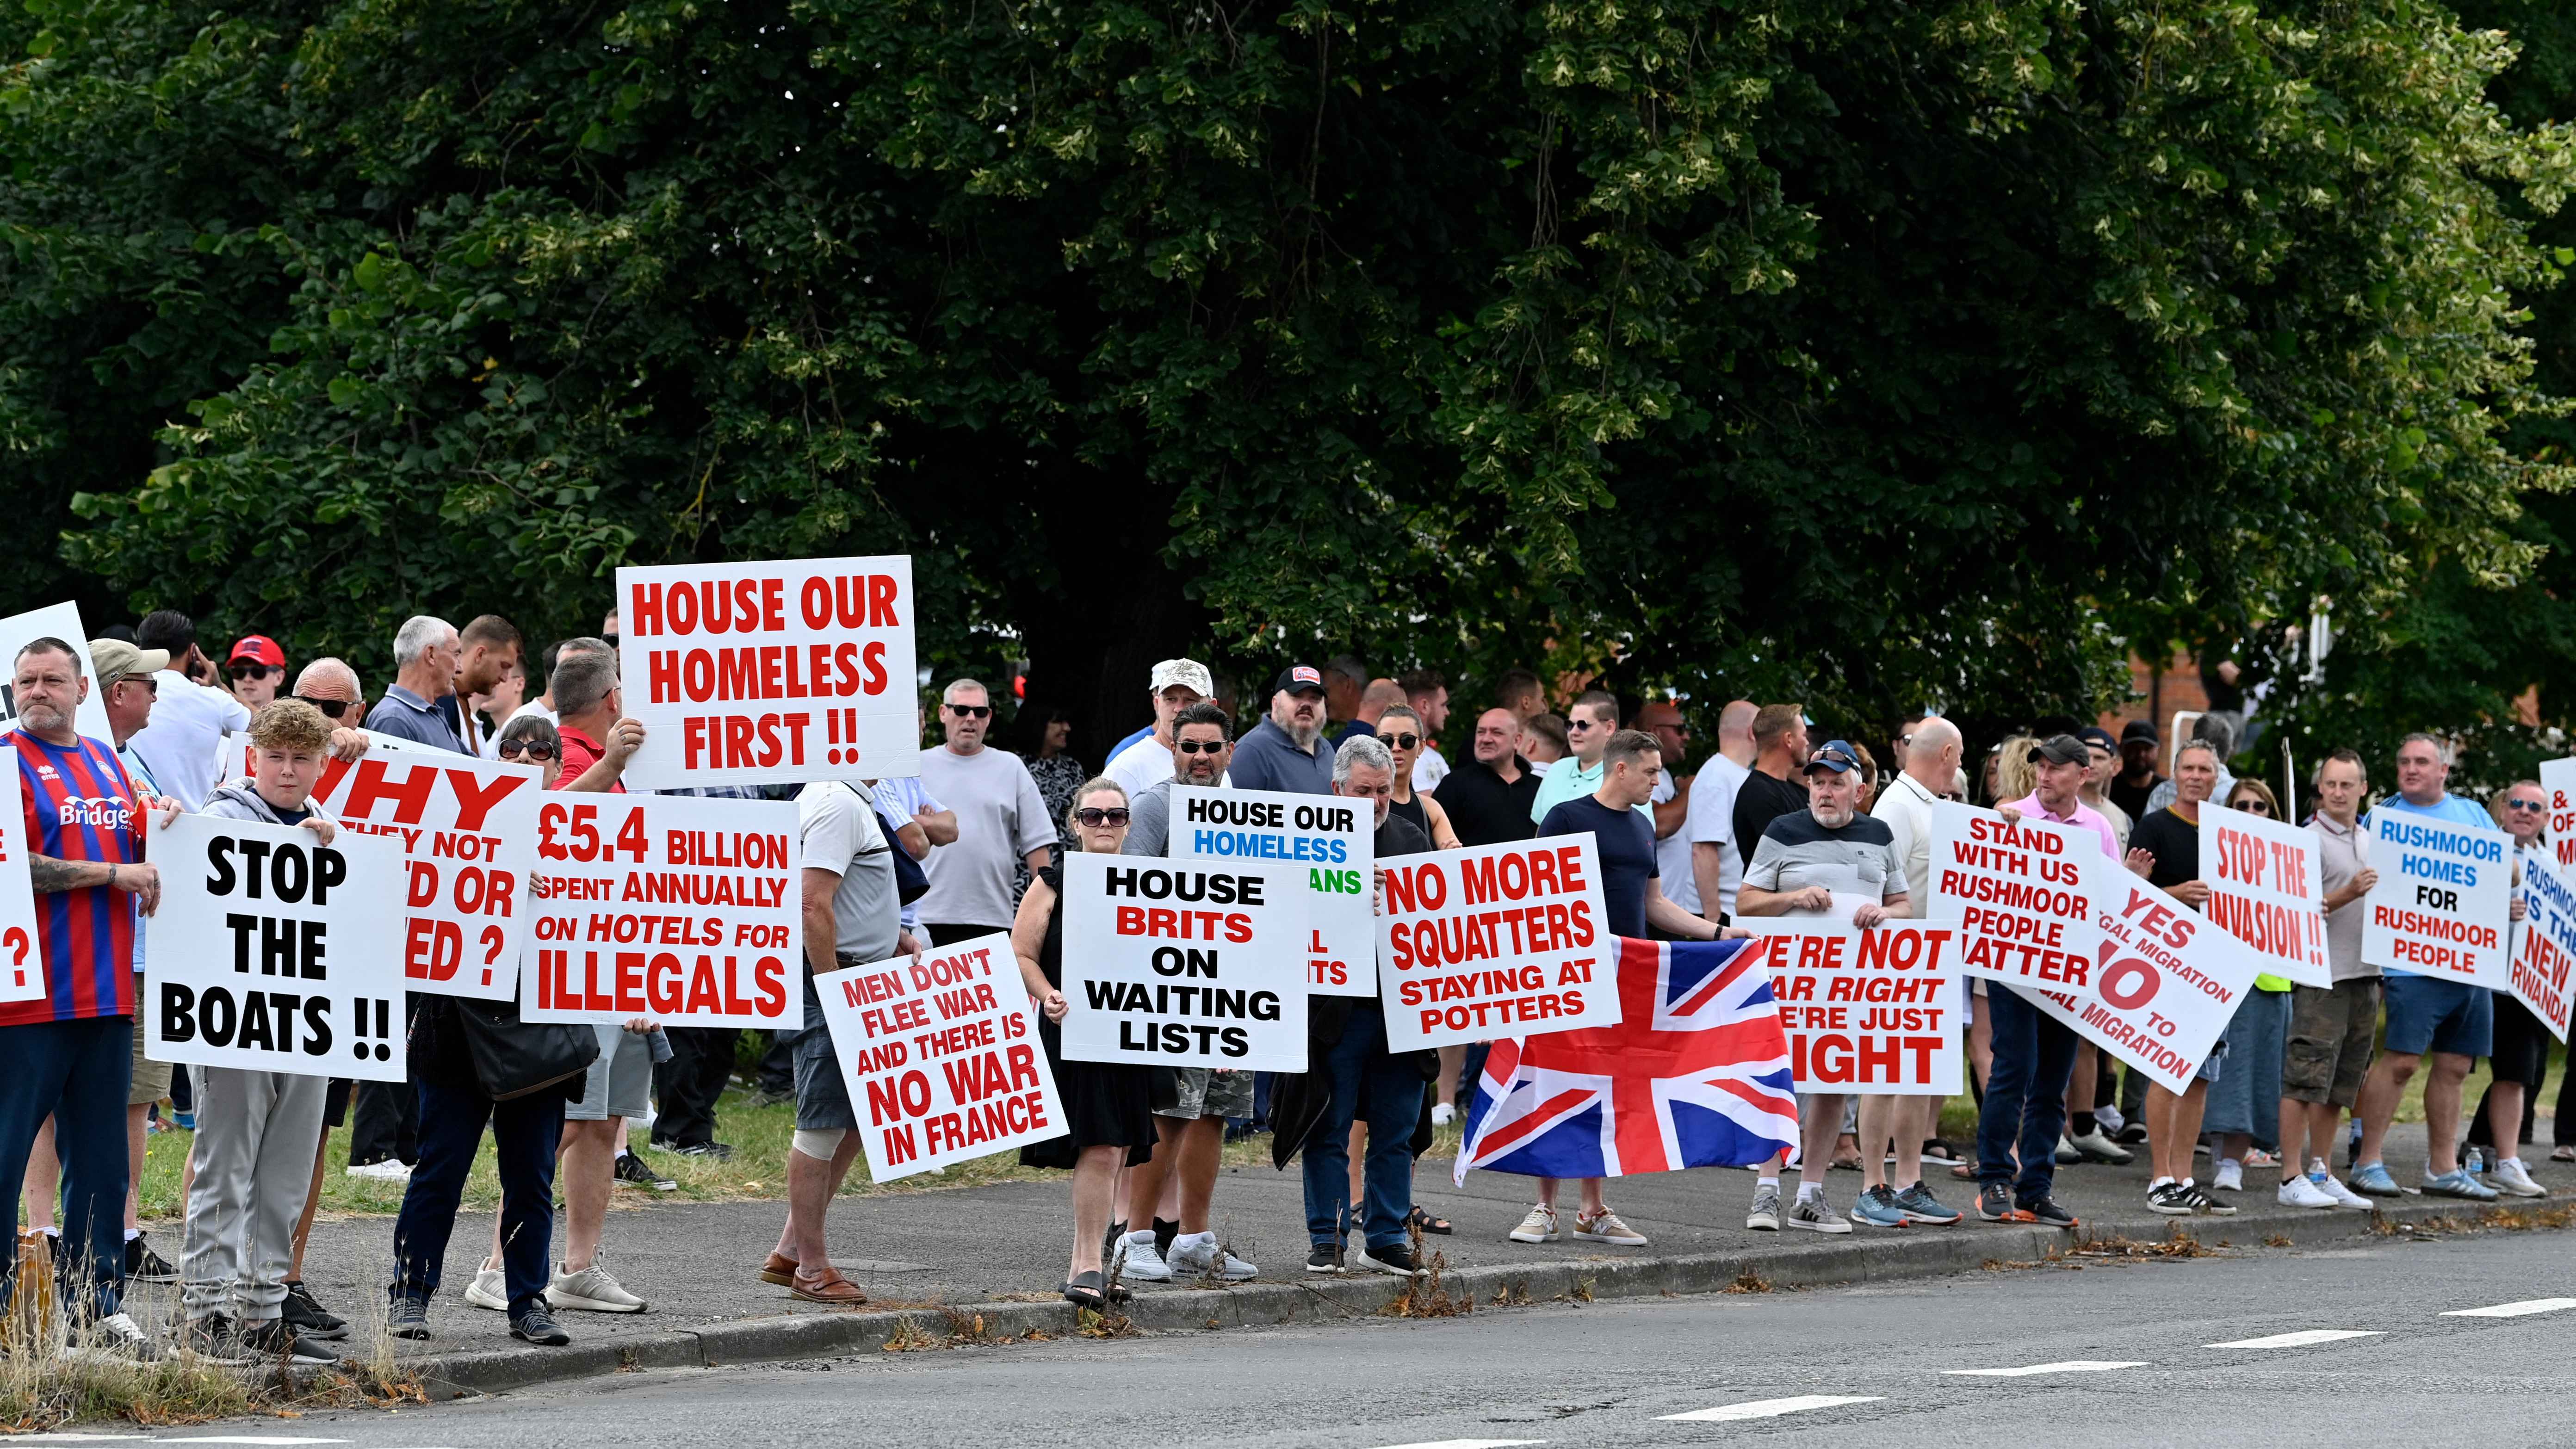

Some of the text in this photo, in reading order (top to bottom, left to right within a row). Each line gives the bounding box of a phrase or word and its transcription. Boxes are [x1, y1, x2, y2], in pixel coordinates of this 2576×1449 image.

[633, 575, 899, 636] HOUSE OUR
[650, 642, 887, 703] HOMELESS
[685, 708, 859, 769] FIRST !!
[1189, 799, 1353, 832] HOUSE OUR
[2553, 790, 2568, 809] &
[433, 832, 502, 862] NOT
[539, 803, 787, 869] £5.4 BILLION
[1194, 829, 1347, 864] HOMELESS
[1971, 818, 2063, 855] STAND
[2380, 819, 2502, 863] RUSHMOOR
[2557, 838, 2576, 866] M
[207, 836, 346, 905] STOP
[1107, 867, 1263, 905] HOUSE
[1384, 846, 1586, 914] NO MORE
[1954, 842, 2078, 886] WITH US
[2219, 828, 2306, 897] STOP THE
[2401, 854, 2477, 887] HOMES
[405, 860, 514, 917] D OR
[538, 872, 788, 907] SPENT ANNUALLY
[1941, 870, 2088, 920] RUSHMOOR
[2417, 886, 2457, 911] FOR
[2526, 858, 2576, 923] RUSHMO
[536, 914, 789, 947] ON HOTELS FOR
[1118, 906, 1252, 942] BRITS
[1308, 929, 1328, 954] L
[1392, 900, 1594, 970] SQUATTERS
[1963, 907, 2063, 947] PEOPLE
[2122, 888, 2196, 949] YES
[2208, 889, 2323, 966] INVASION !!
[2376, 906, 2496, 948] RUSHMOOR
[4, 927, 29, 986] ?
[227, 913, 326, 980] THE
[405, 917, 503, 985] ED ?
[1152, 947, 1217, 978] ON
[1762, 929, 1952, 970] E'RE NOT
[1962, 934, 2090, 987] ATTER
[2099, 910, 2233, 1003] GAL MIGRATION
[2395, 940, 2475, 973] PEOPLE
[2524, 925, 2571, 993] NEW
[539, 950, 786, 1017] ILLEGALS
[843, 949, 991, 1007] MEN DON'T
[1084, 980, 1280, 1021] WAITING
[1401, 959, 1596, 1005] STAYING AT
[1770, 976, 1945, 1003] AR RIGHT
[2512, 957, 2567, 1032] RWANDA
[161, 983, 390, 1061] BOATS !!
[862, 985, 997, 1038] FLEE WAR
[1421, 991, 1585, 1034] POTTERS
[1779, 1006, 1944, 1031] E'RE JUST
[2149, 1014, 2175, 1036] TO
[859, 1013, 1026, 1075] AND THERE IS
[1121, 1021, 1248, 1057] LISTS
[1792, 1034, 1943, 1084] IGHT
[2081, 1003, 2192, 1079] MIGRATION
[867, 1044, 1039, 1126] NO WAR
[884, 1091, 1047, 1165] IN FRANCE
